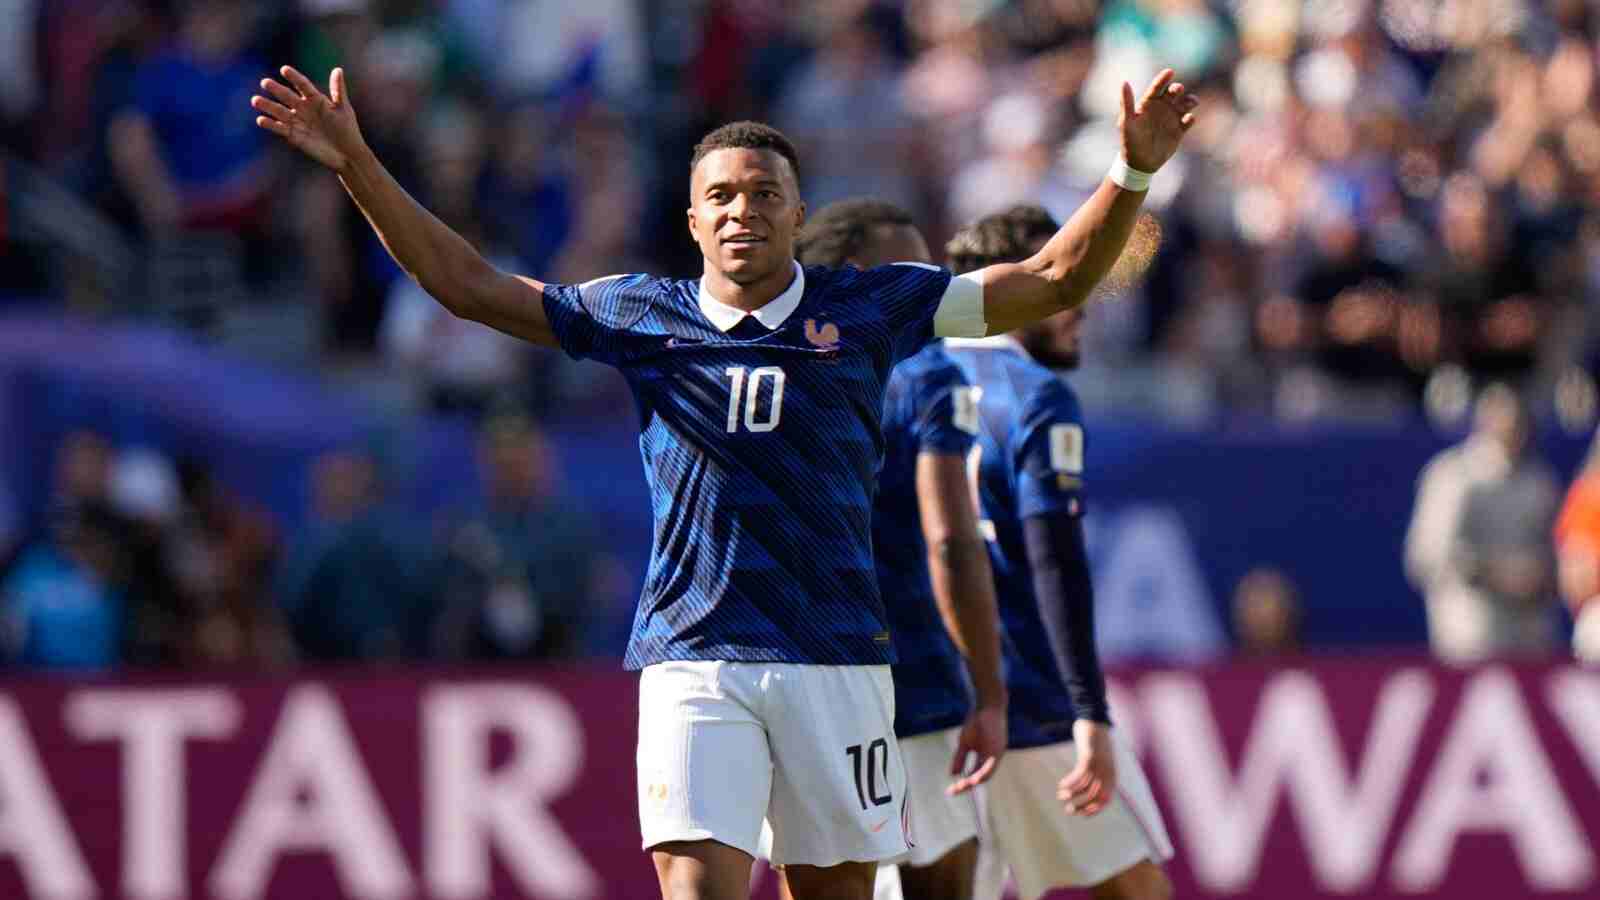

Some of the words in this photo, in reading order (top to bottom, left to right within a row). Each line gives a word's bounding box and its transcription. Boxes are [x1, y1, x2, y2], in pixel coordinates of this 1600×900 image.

[725, 367, 785, 433] 10
[846, 738, 892, 810] 10
[1110, 668, 1600, 893] WA
